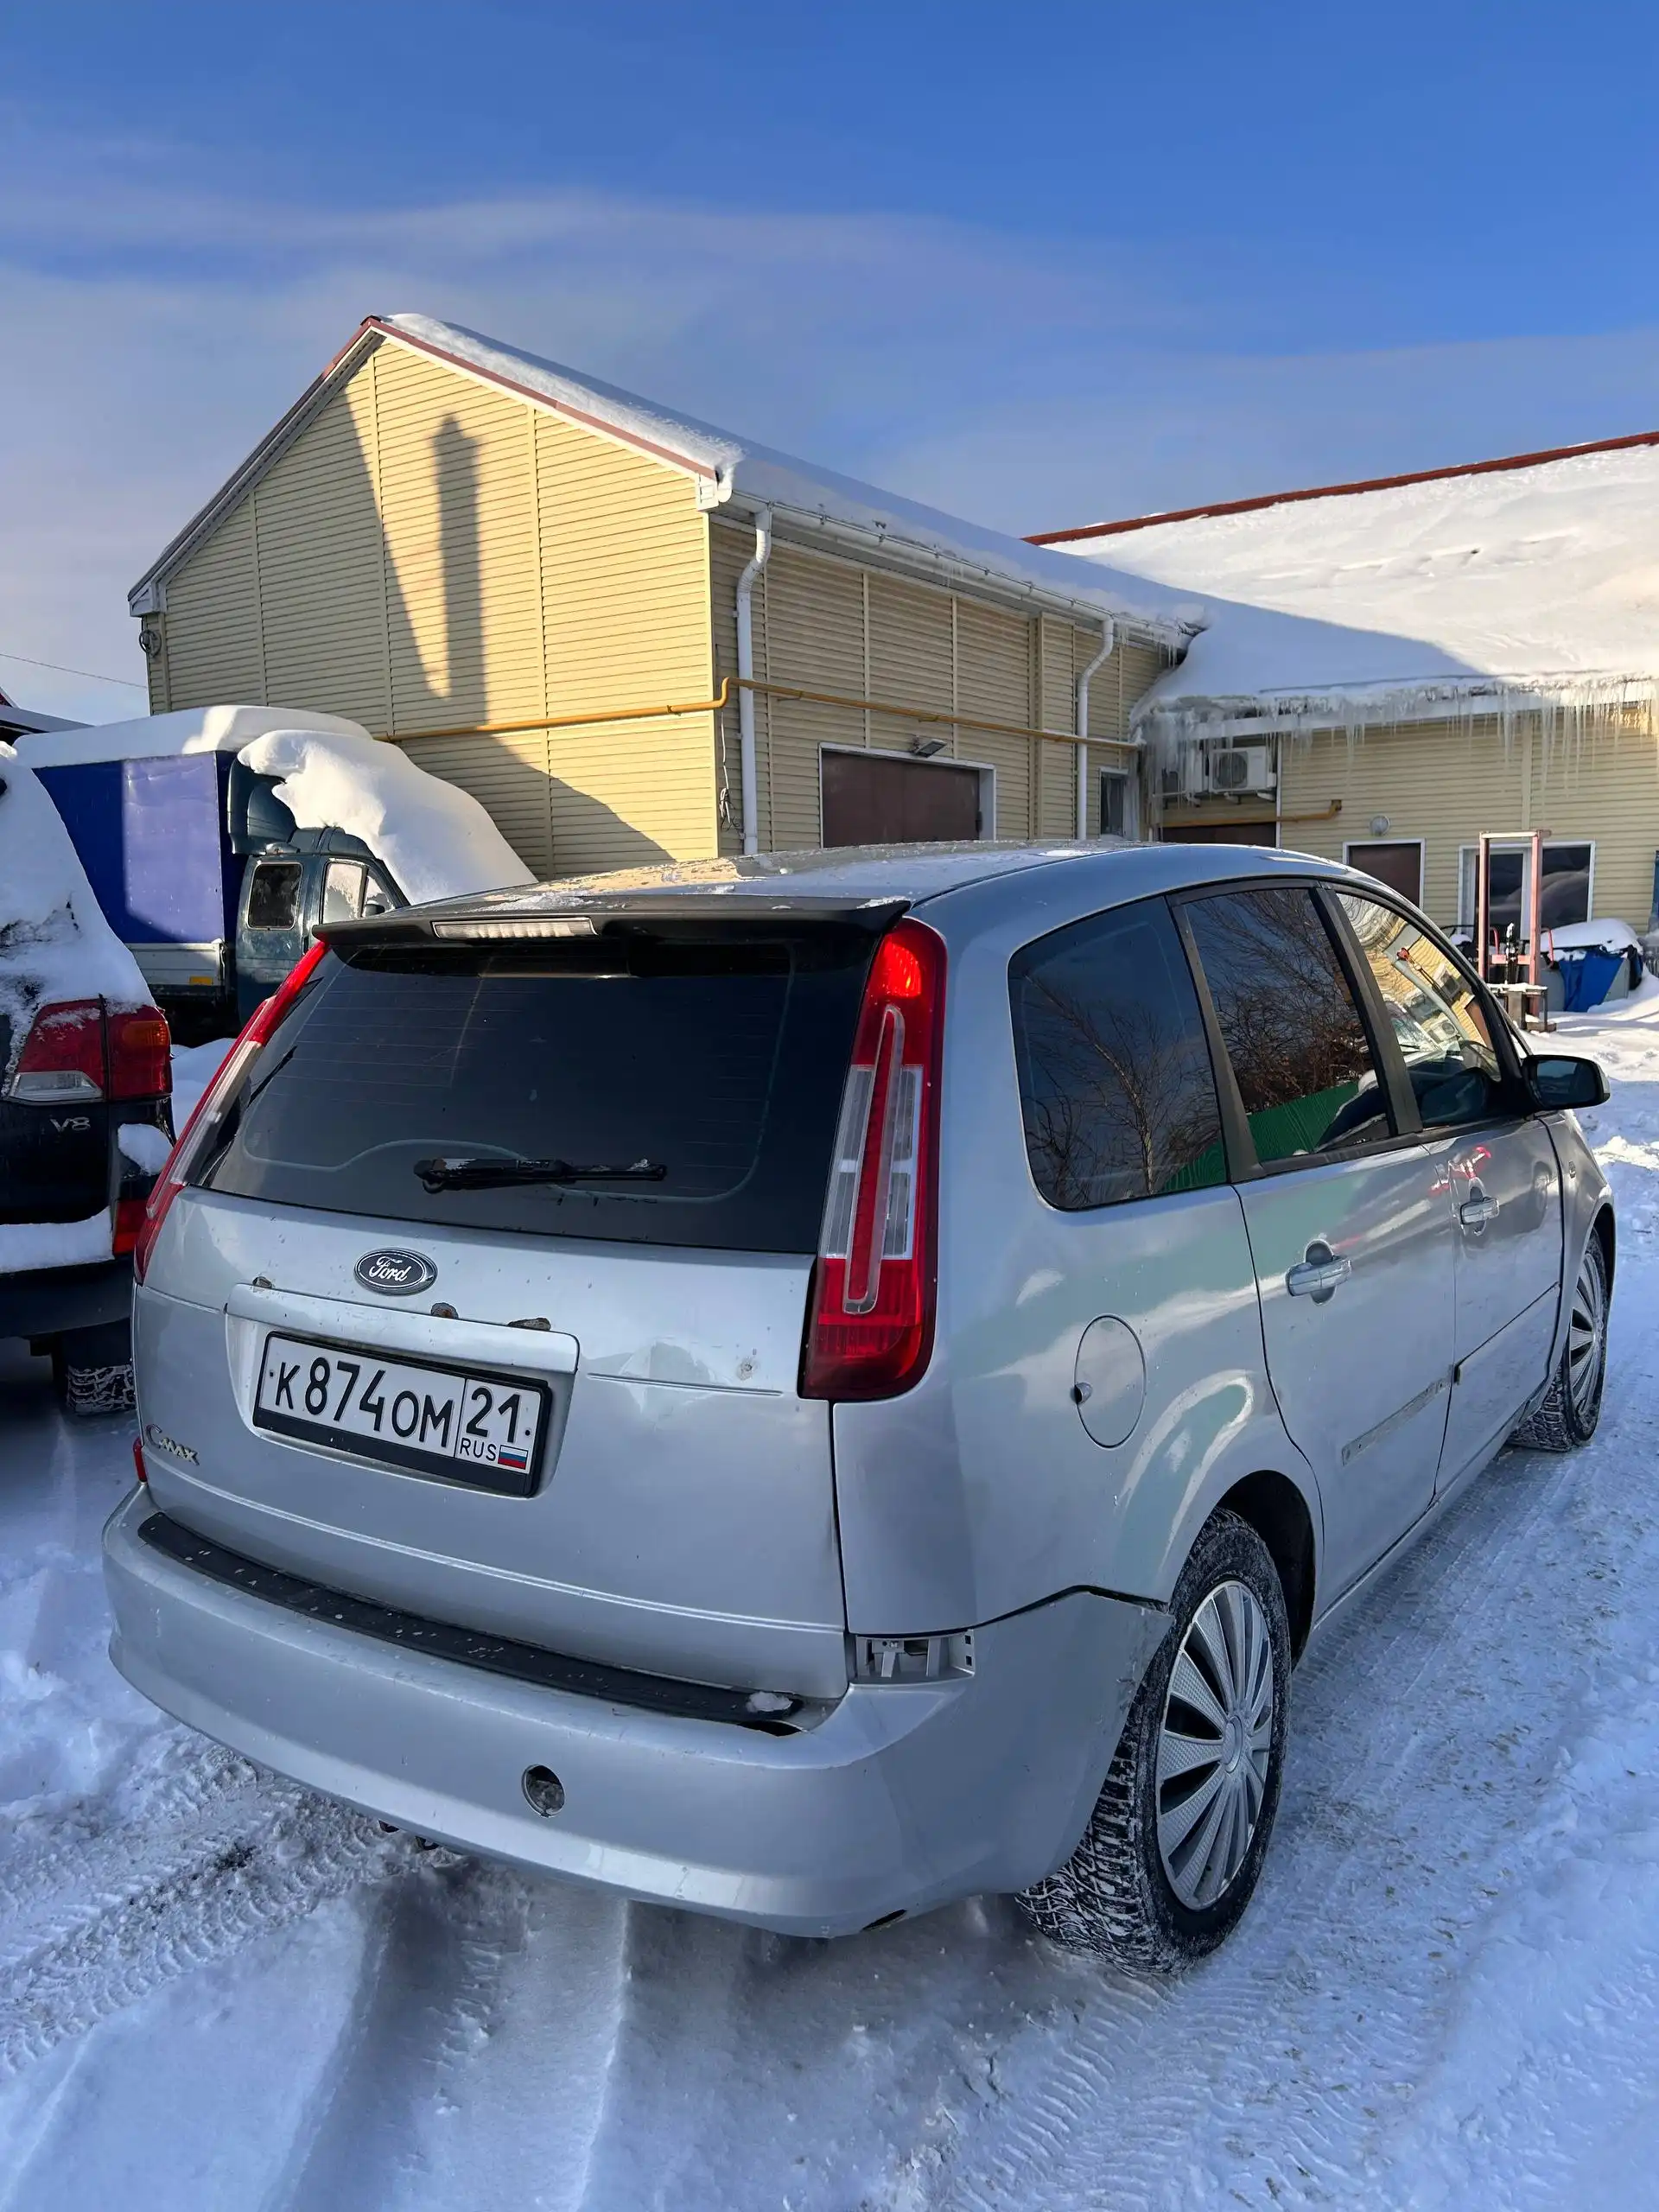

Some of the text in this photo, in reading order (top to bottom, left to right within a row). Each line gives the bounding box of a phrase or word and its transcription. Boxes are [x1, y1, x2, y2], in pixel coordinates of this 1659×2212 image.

[49, 1116, 91, 1132] V8
[368, 1255, 412, 1282] Ford
[465, 1387, 520, 1443] 21
[459, 1437, 497, 1462] RUS
